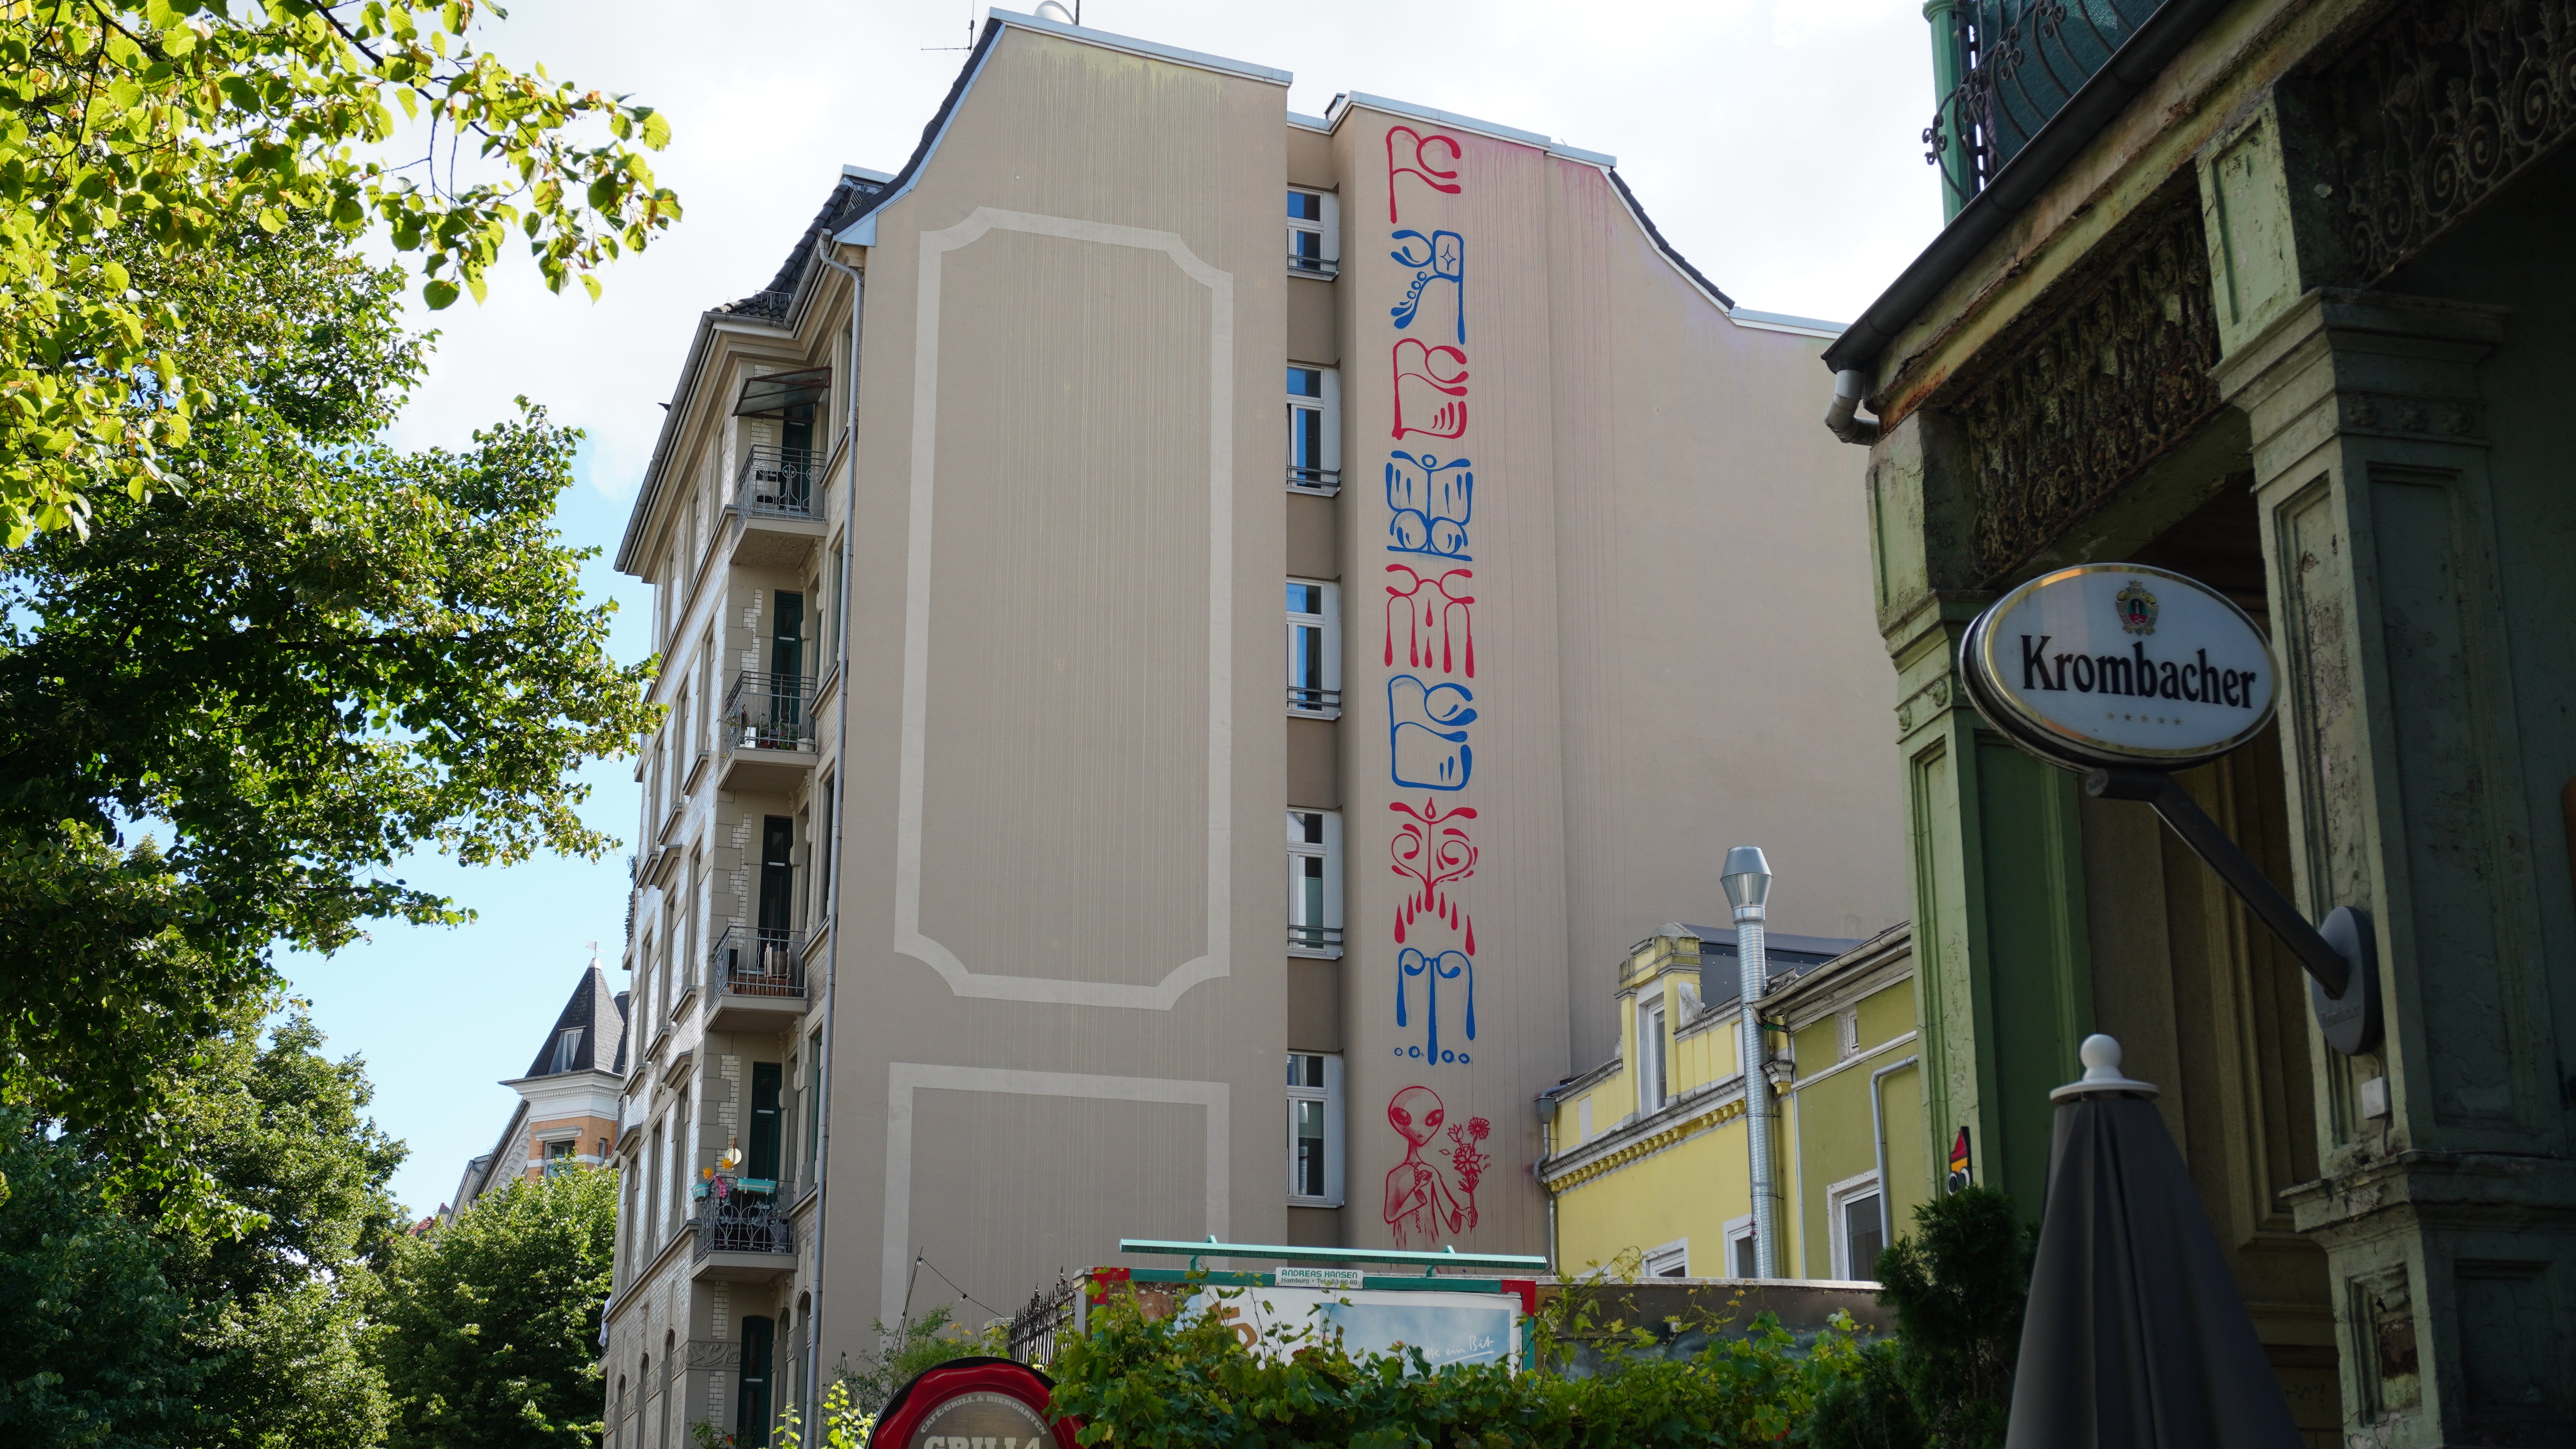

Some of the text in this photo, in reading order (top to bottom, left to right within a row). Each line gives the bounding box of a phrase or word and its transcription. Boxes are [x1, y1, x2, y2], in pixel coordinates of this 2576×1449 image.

[2021, 635, 2256, 709] Krombacher
[1282, 1269, 1322, 1277] ANDREAS
[1445, 1345, 1466, 1356] ein
[1469, 1335, 1494, 1351] Bit
[920, 1396, 975, 1433] CAFÉ/GRILL
[986, 1395, 1047, 1435] BIERGARTEN
